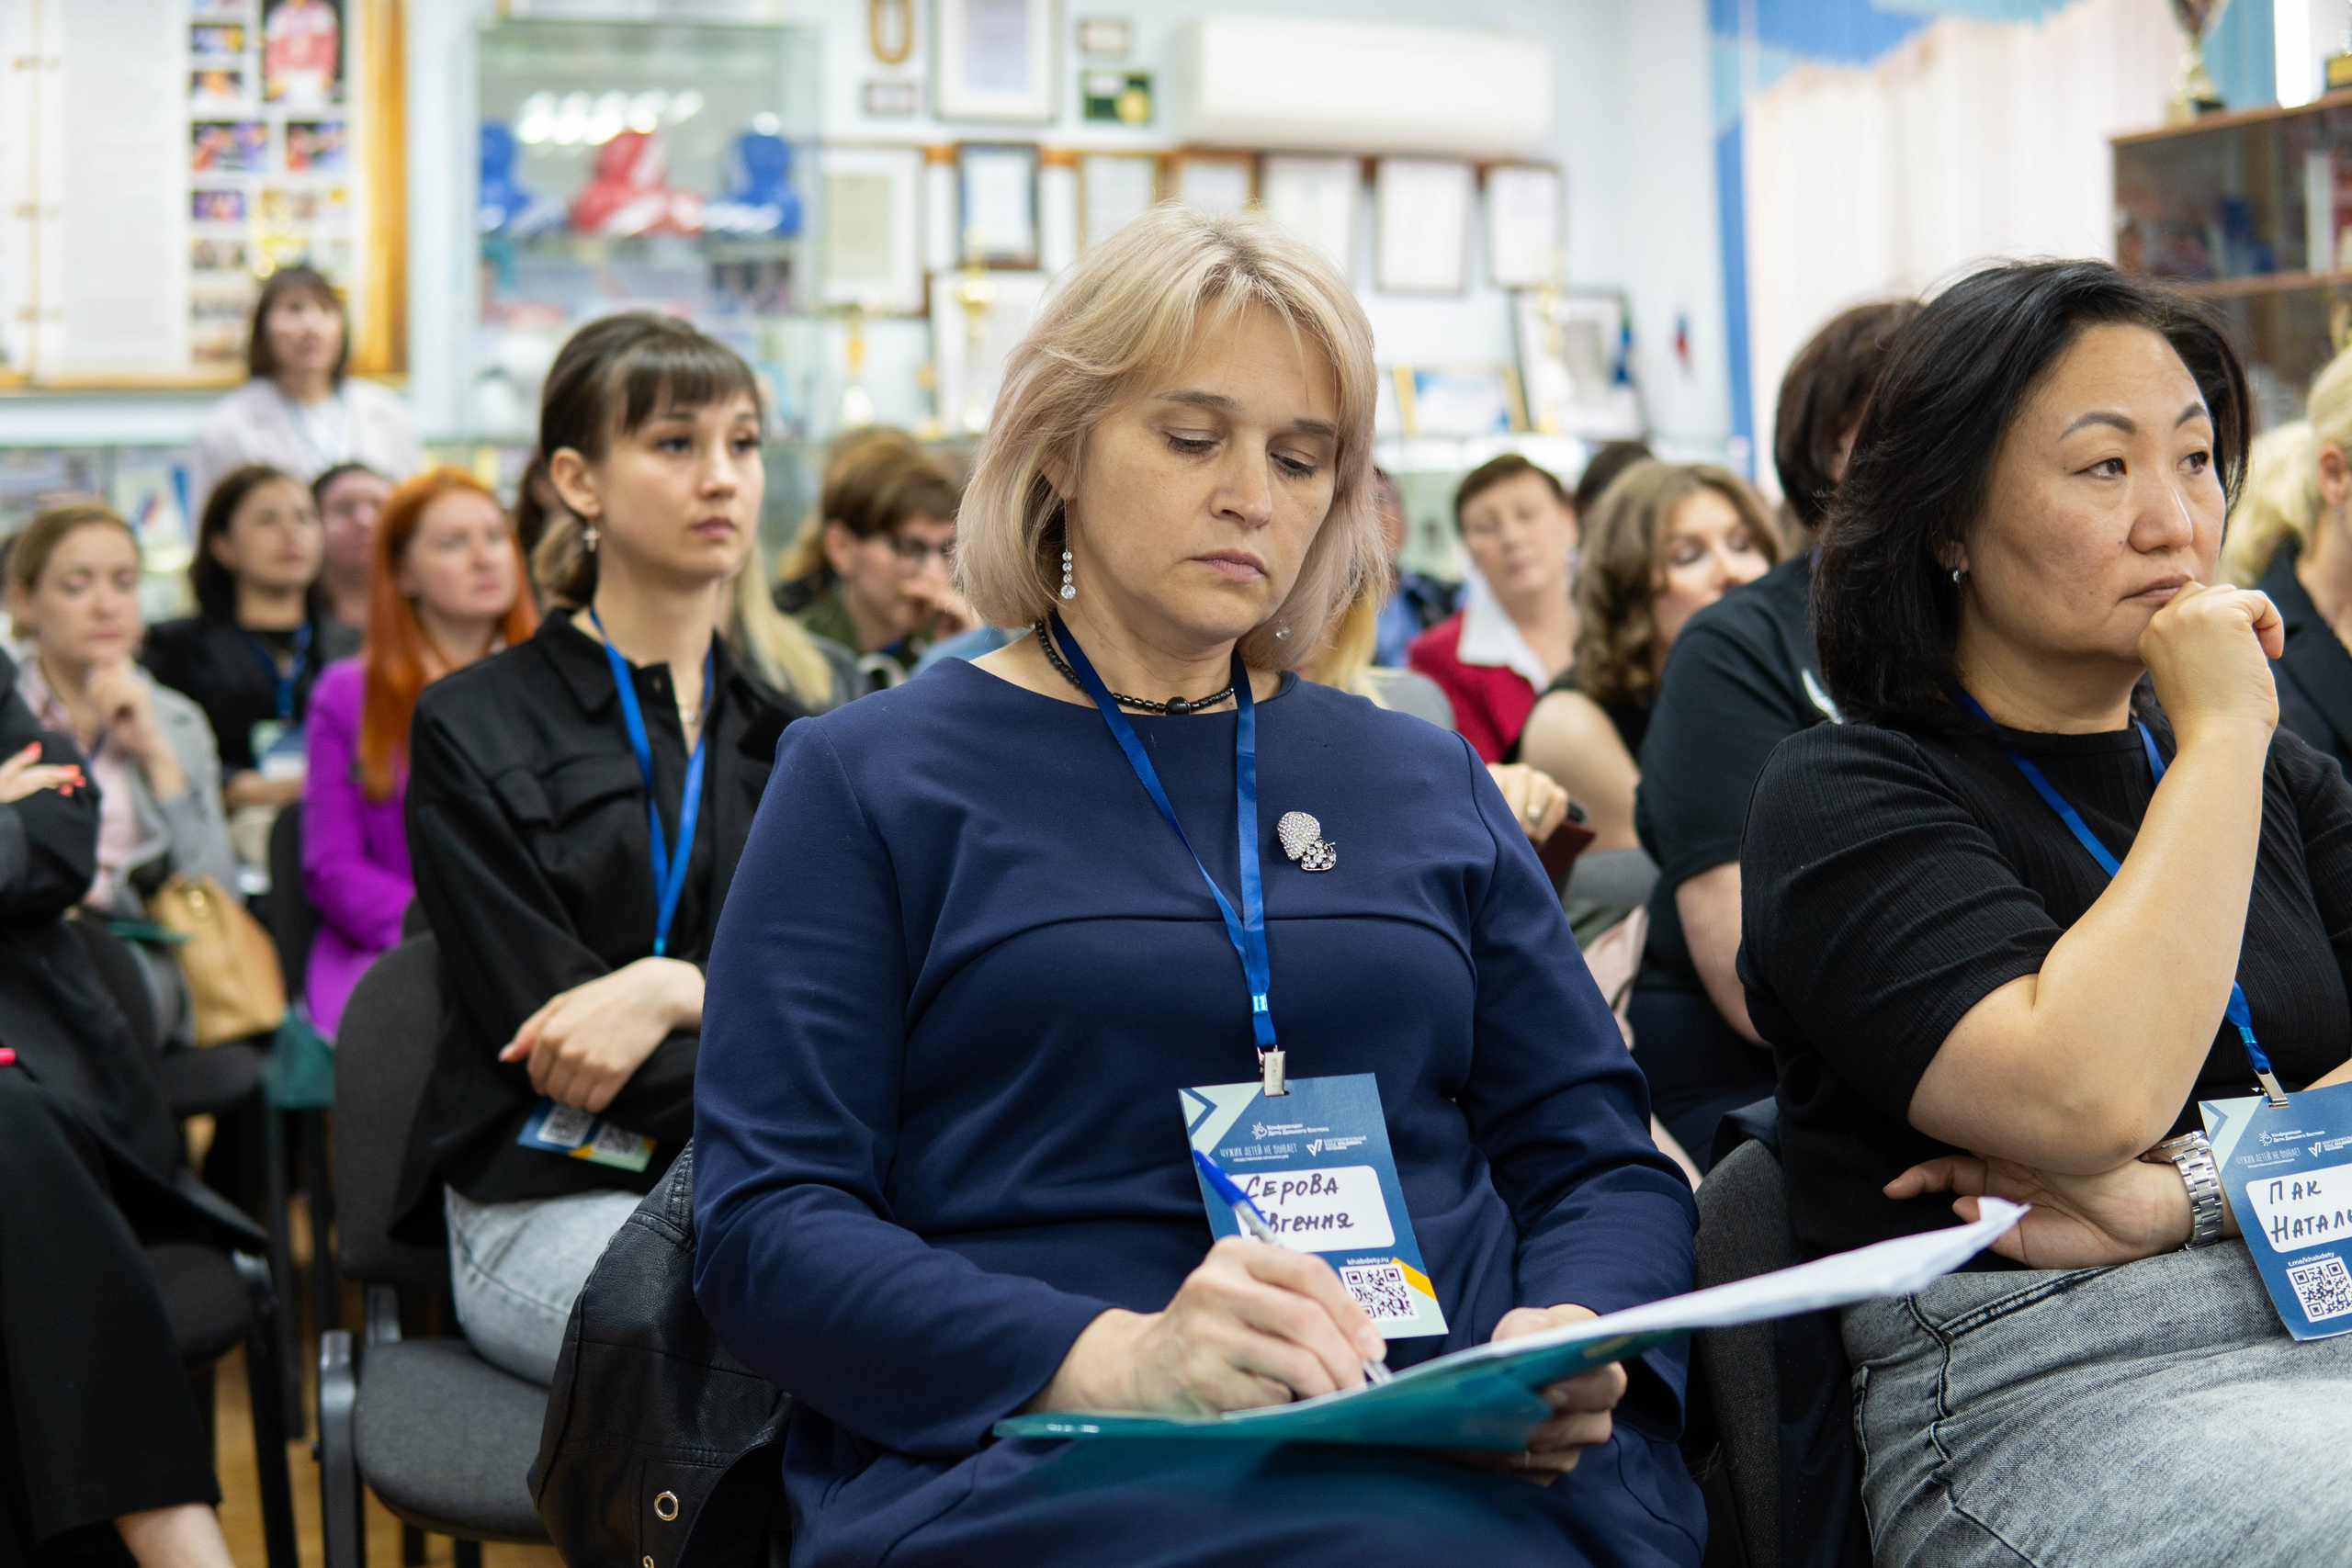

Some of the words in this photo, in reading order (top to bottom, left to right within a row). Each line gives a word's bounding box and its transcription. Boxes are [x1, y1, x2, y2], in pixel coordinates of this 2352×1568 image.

[1220, 1147, 1243, 1157] ЧУЖИХ
[1244, 1144, 1263, 1156] ДЕТЕЙ
[1263, 1145, 1272, 1155] НЕ
[1272, 1143, 1297, 1155] БЫВАЕТ
[2235, 1155, 2256, 1165] ЧУЖИХ
[2256, 1150, 2271, 1162] ДЕТЕЙ
[2271, 1150, 2279, 1159] НЕ
[2279, 1147, 2301, 1158] БЫВАЕТ
[2270, 1180, 2322, 1205] ПАК
[1250, 1211, 1354, 1236] вгения
[1346, 1257, 1390, 1266] khabdety.ru
[2288, 1251, 2335, 1267] t.me/khabdety
